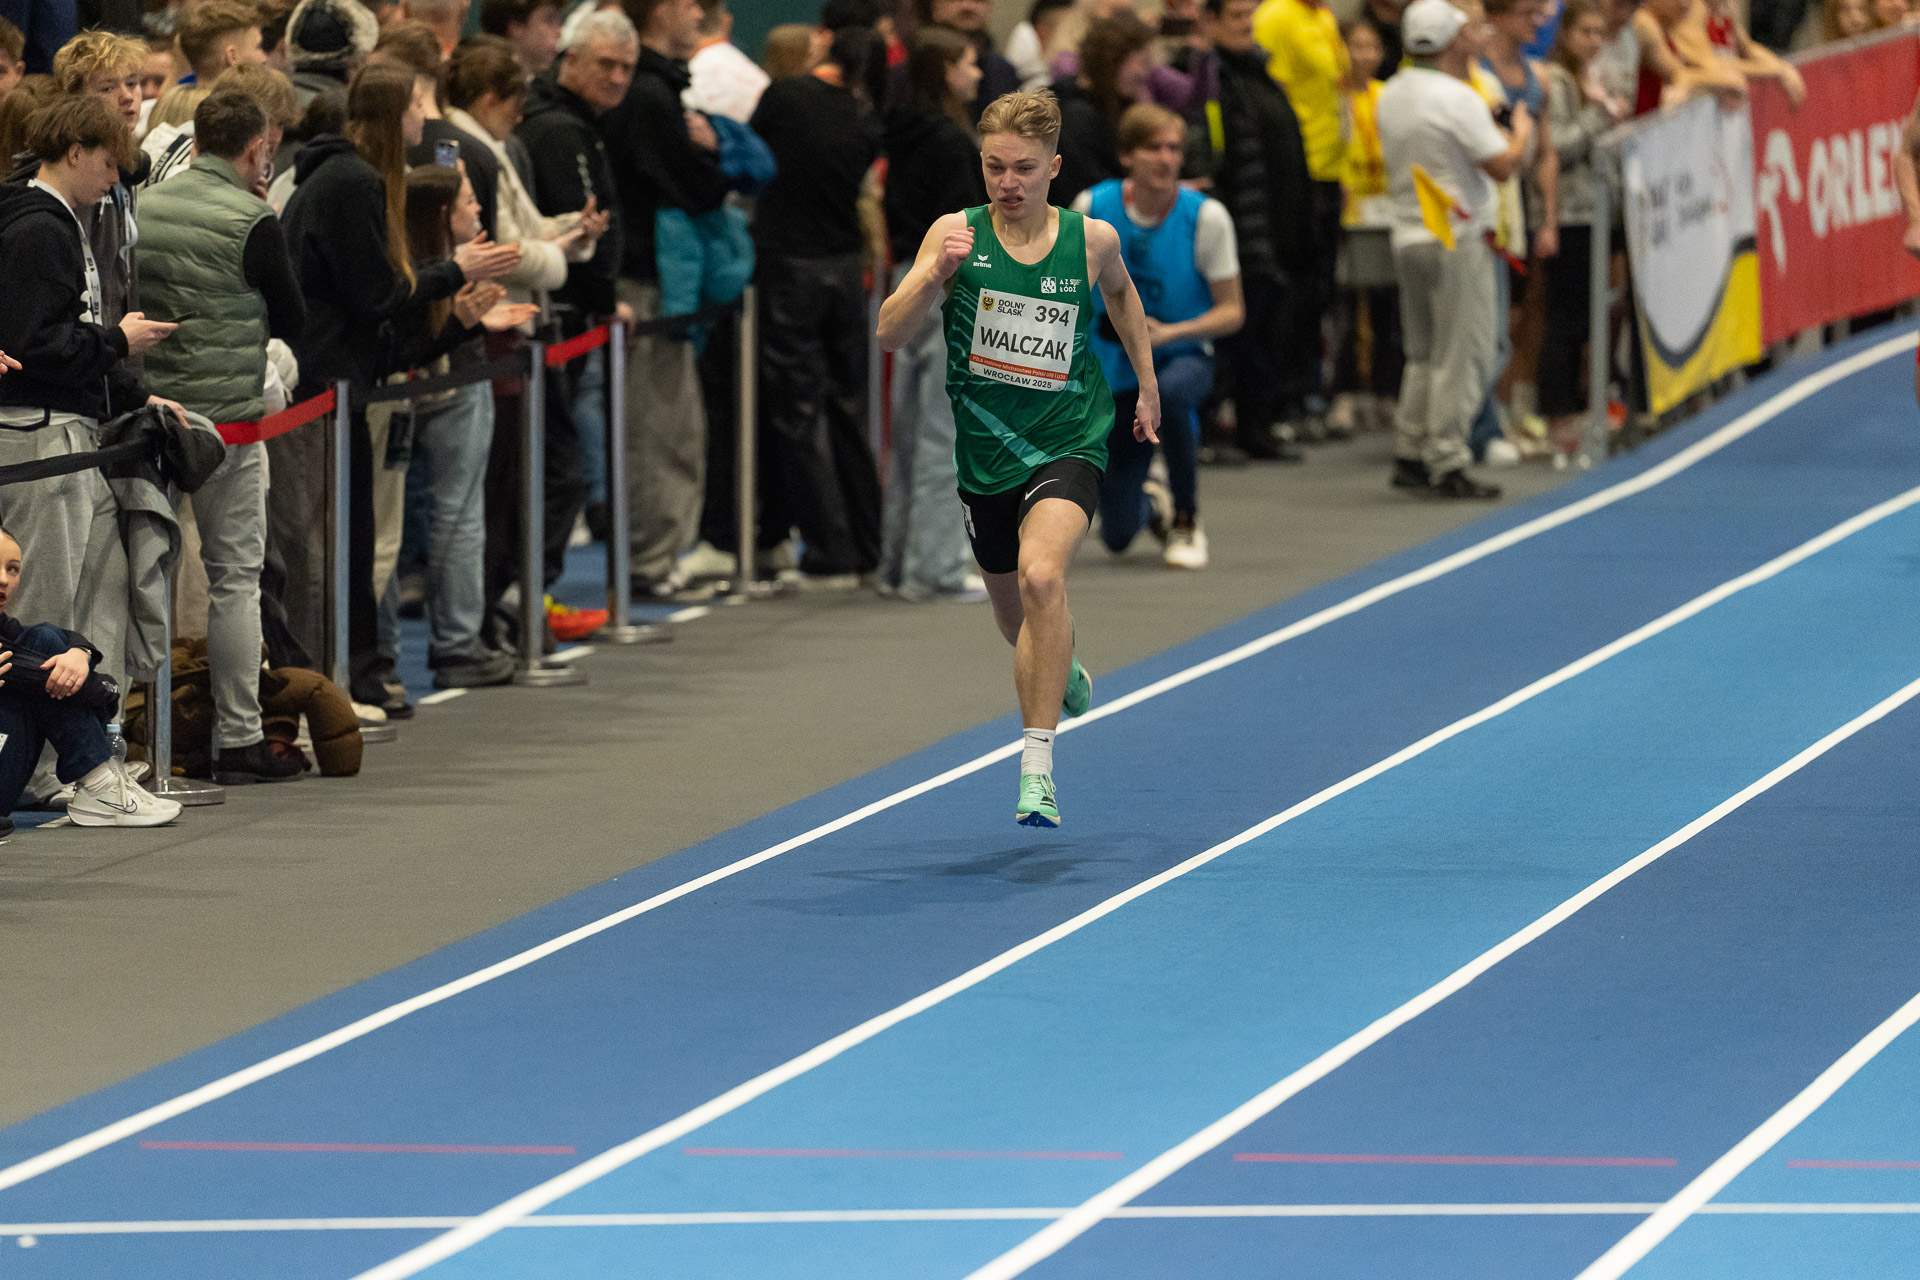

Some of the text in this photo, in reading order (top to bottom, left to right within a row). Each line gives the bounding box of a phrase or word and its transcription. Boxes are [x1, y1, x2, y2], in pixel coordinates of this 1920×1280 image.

[1059, 284, 1077, 293] ŁÓDŹ
[997, 305, 1022, 316] ŚLĄSK
[998, 299, 1025, 309] DOLNY
[1034, 305, 1069, 326] 394
[980, 326, 1068, 361] WALCZAK
[983, 368, 1052, 389] WROCŁAW 2025
